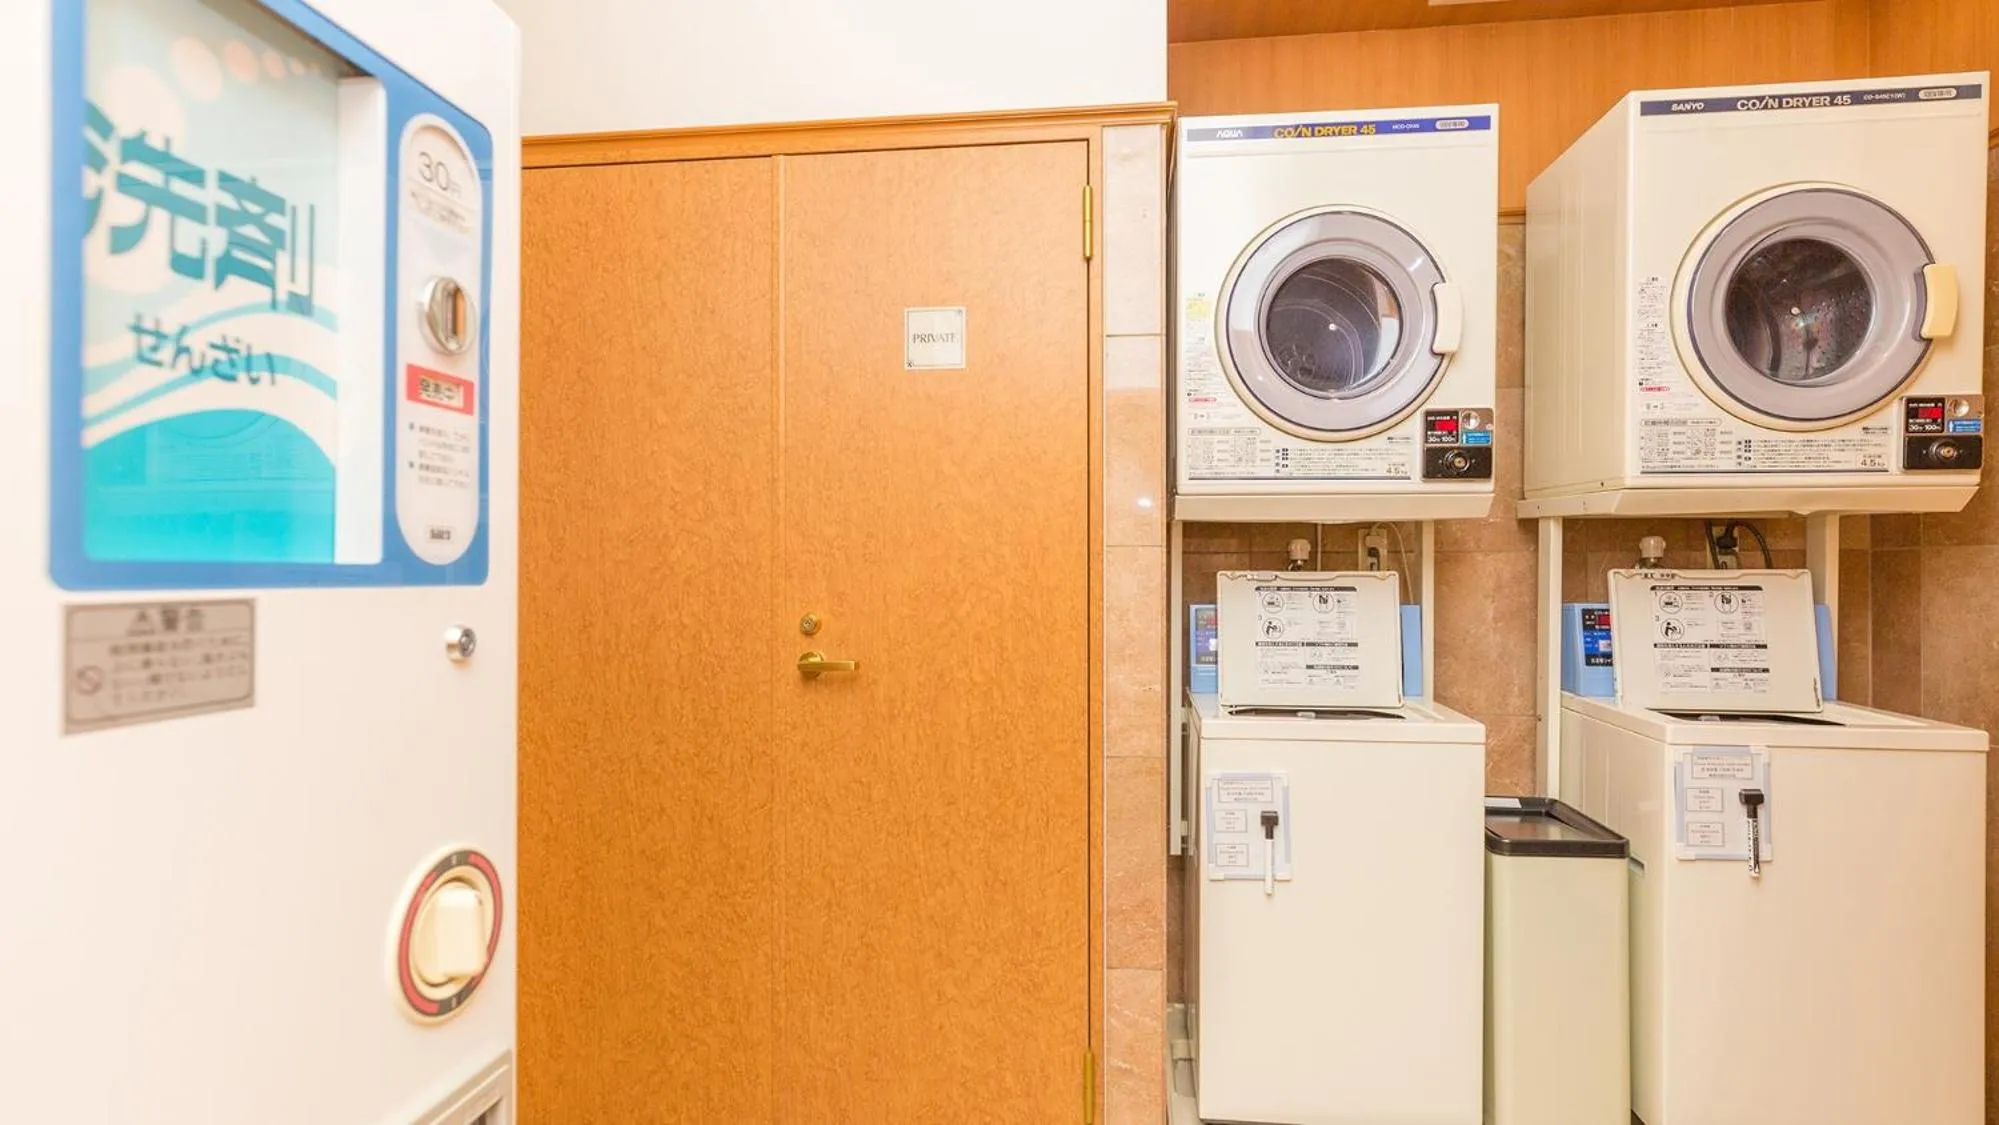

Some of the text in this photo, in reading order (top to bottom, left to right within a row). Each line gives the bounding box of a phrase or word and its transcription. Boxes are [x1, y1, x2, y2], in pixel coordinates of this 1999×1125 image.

[1671, 102, 1704, 111] SANYO
[1782, 97, 1832, 109] DRYER
[1833, 96, 1851, 106] 45
[1216, 129, 1243, 138] AQUA
[1314, 125, 1357, 137] DRYER
[1359, 124, 1376, 135] 45
[127, 311, 277, 386] せんざい
